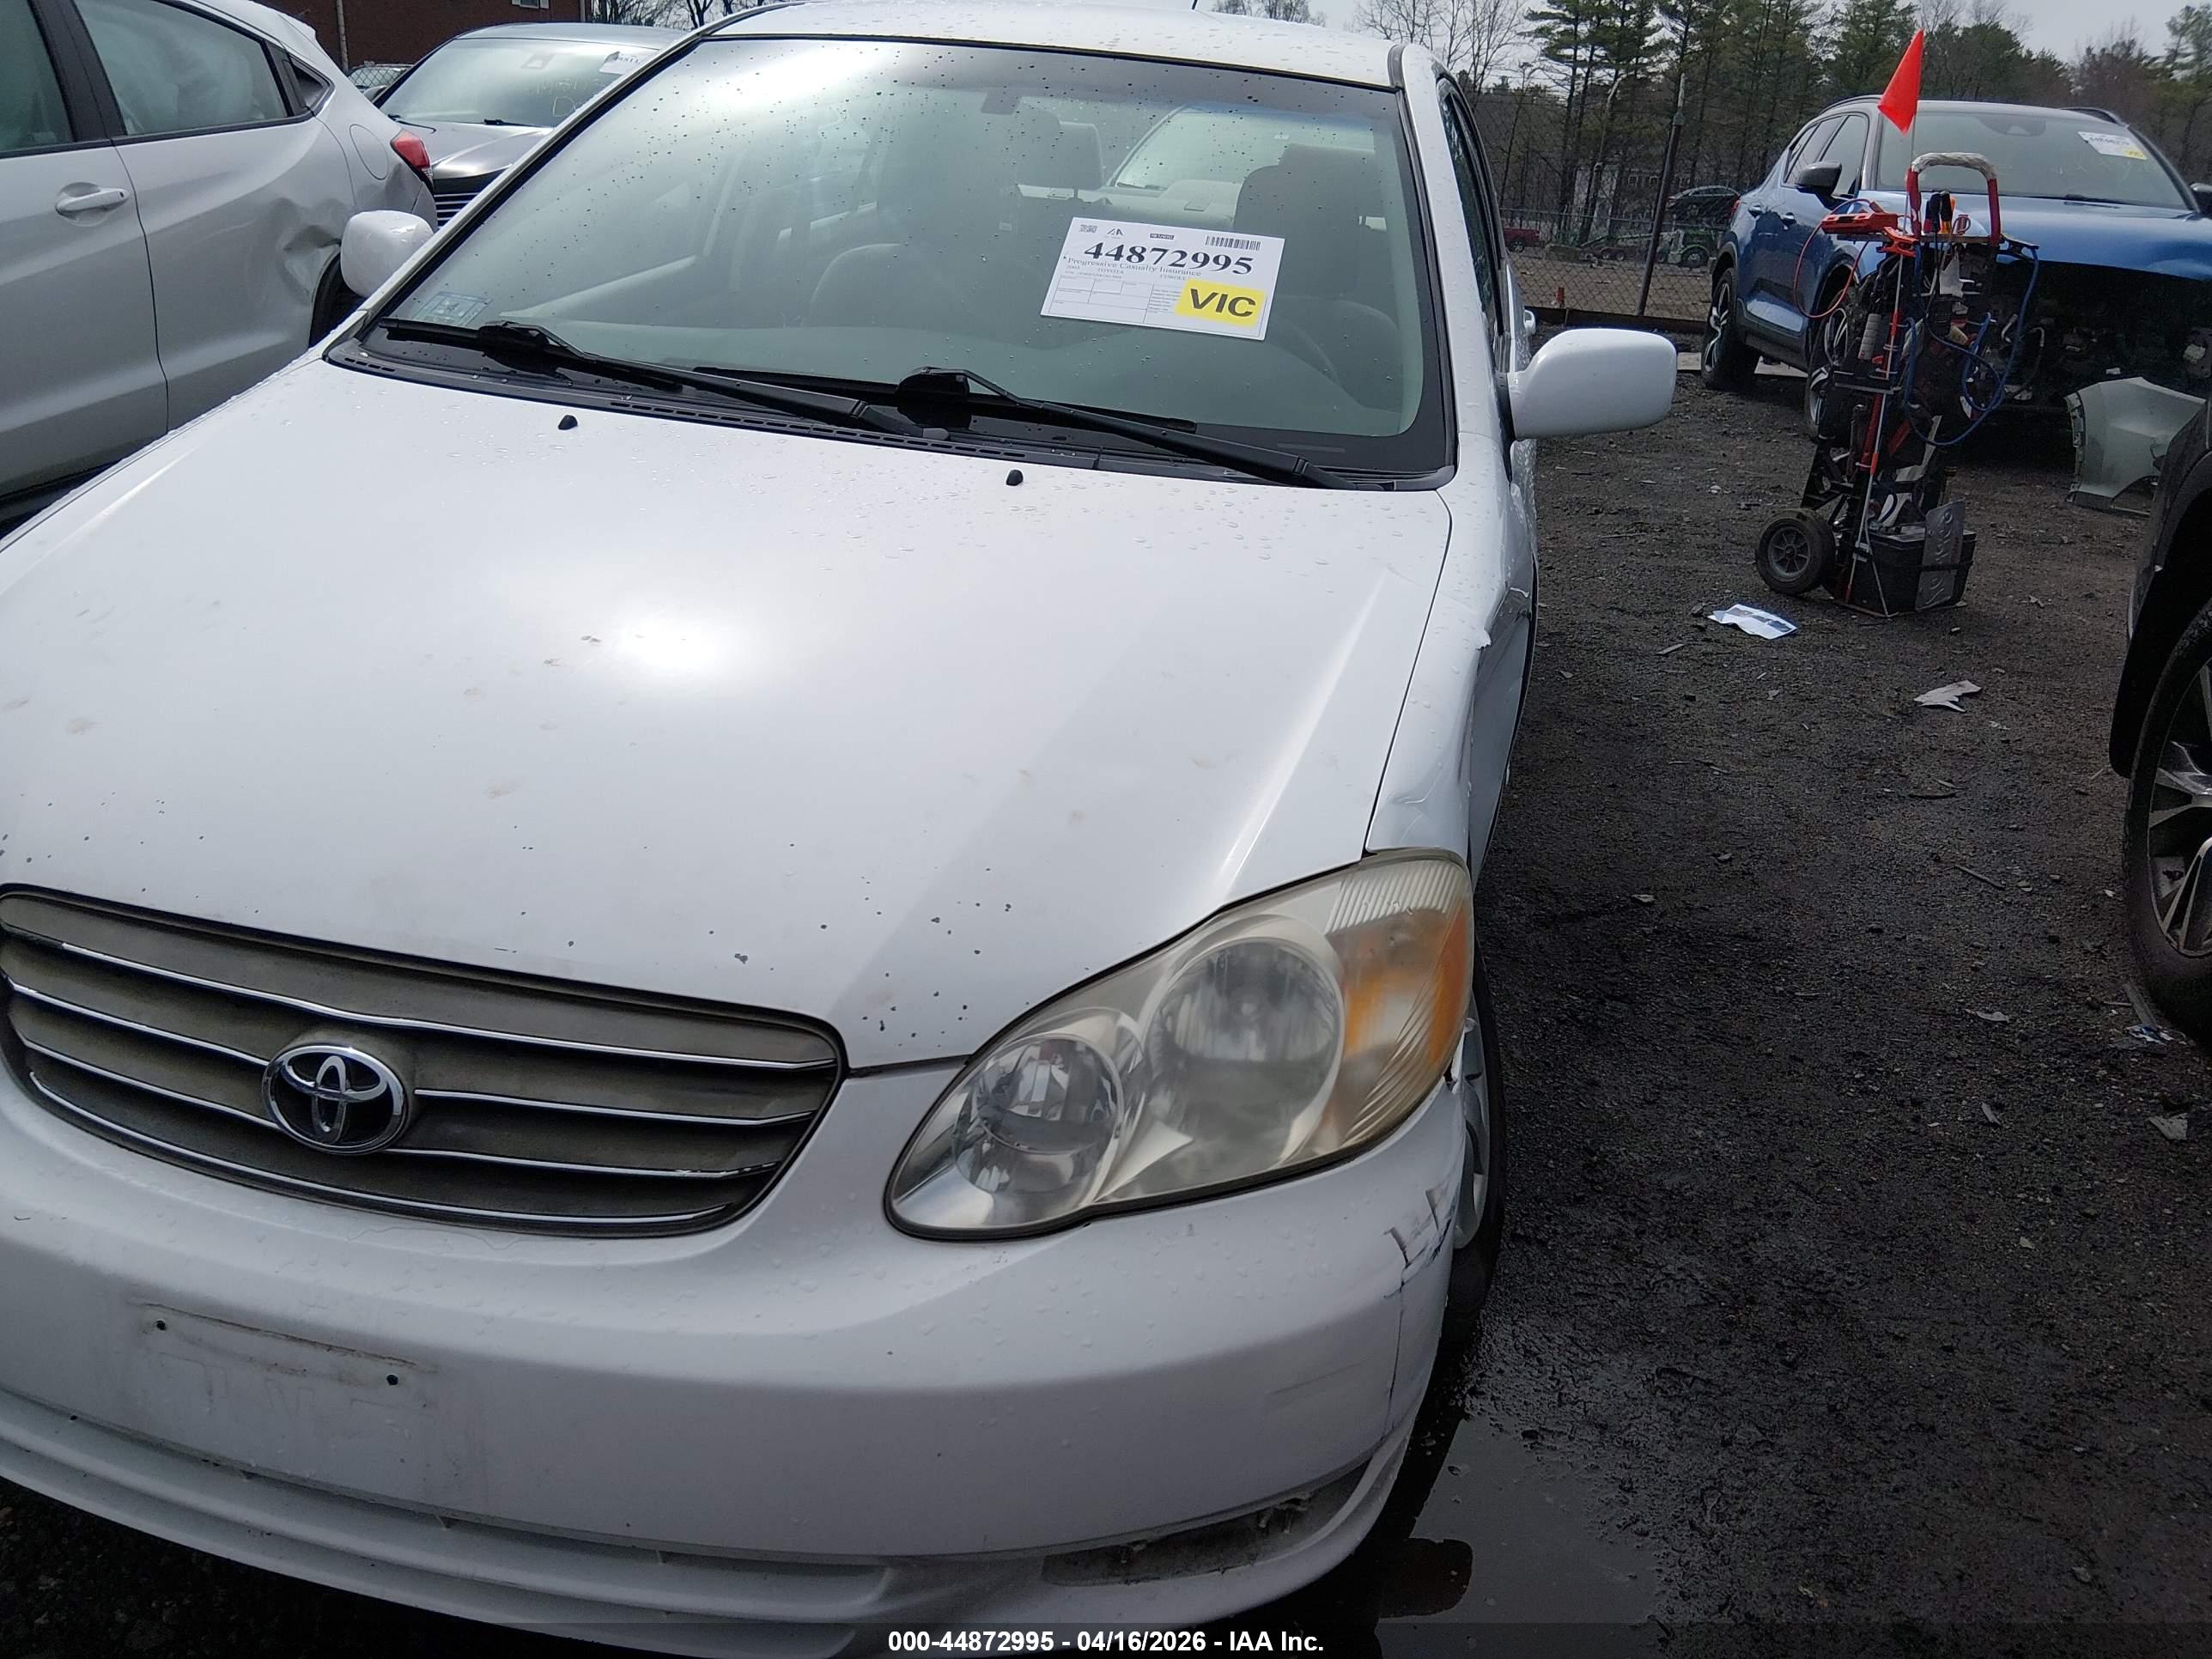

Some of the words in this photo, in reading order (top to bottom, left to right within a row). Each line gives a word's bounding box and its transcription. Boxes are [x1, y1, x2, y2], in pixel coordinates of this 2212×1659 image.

[1067, 257, 1117, 268] Progressive
[1119, 262, 1158, 272] Casualty
[1159, 266, 1202, 276] Insurance
[1084, 242, 1255, 275] 44872995
[1190, 288, 1256, 317] VIC
